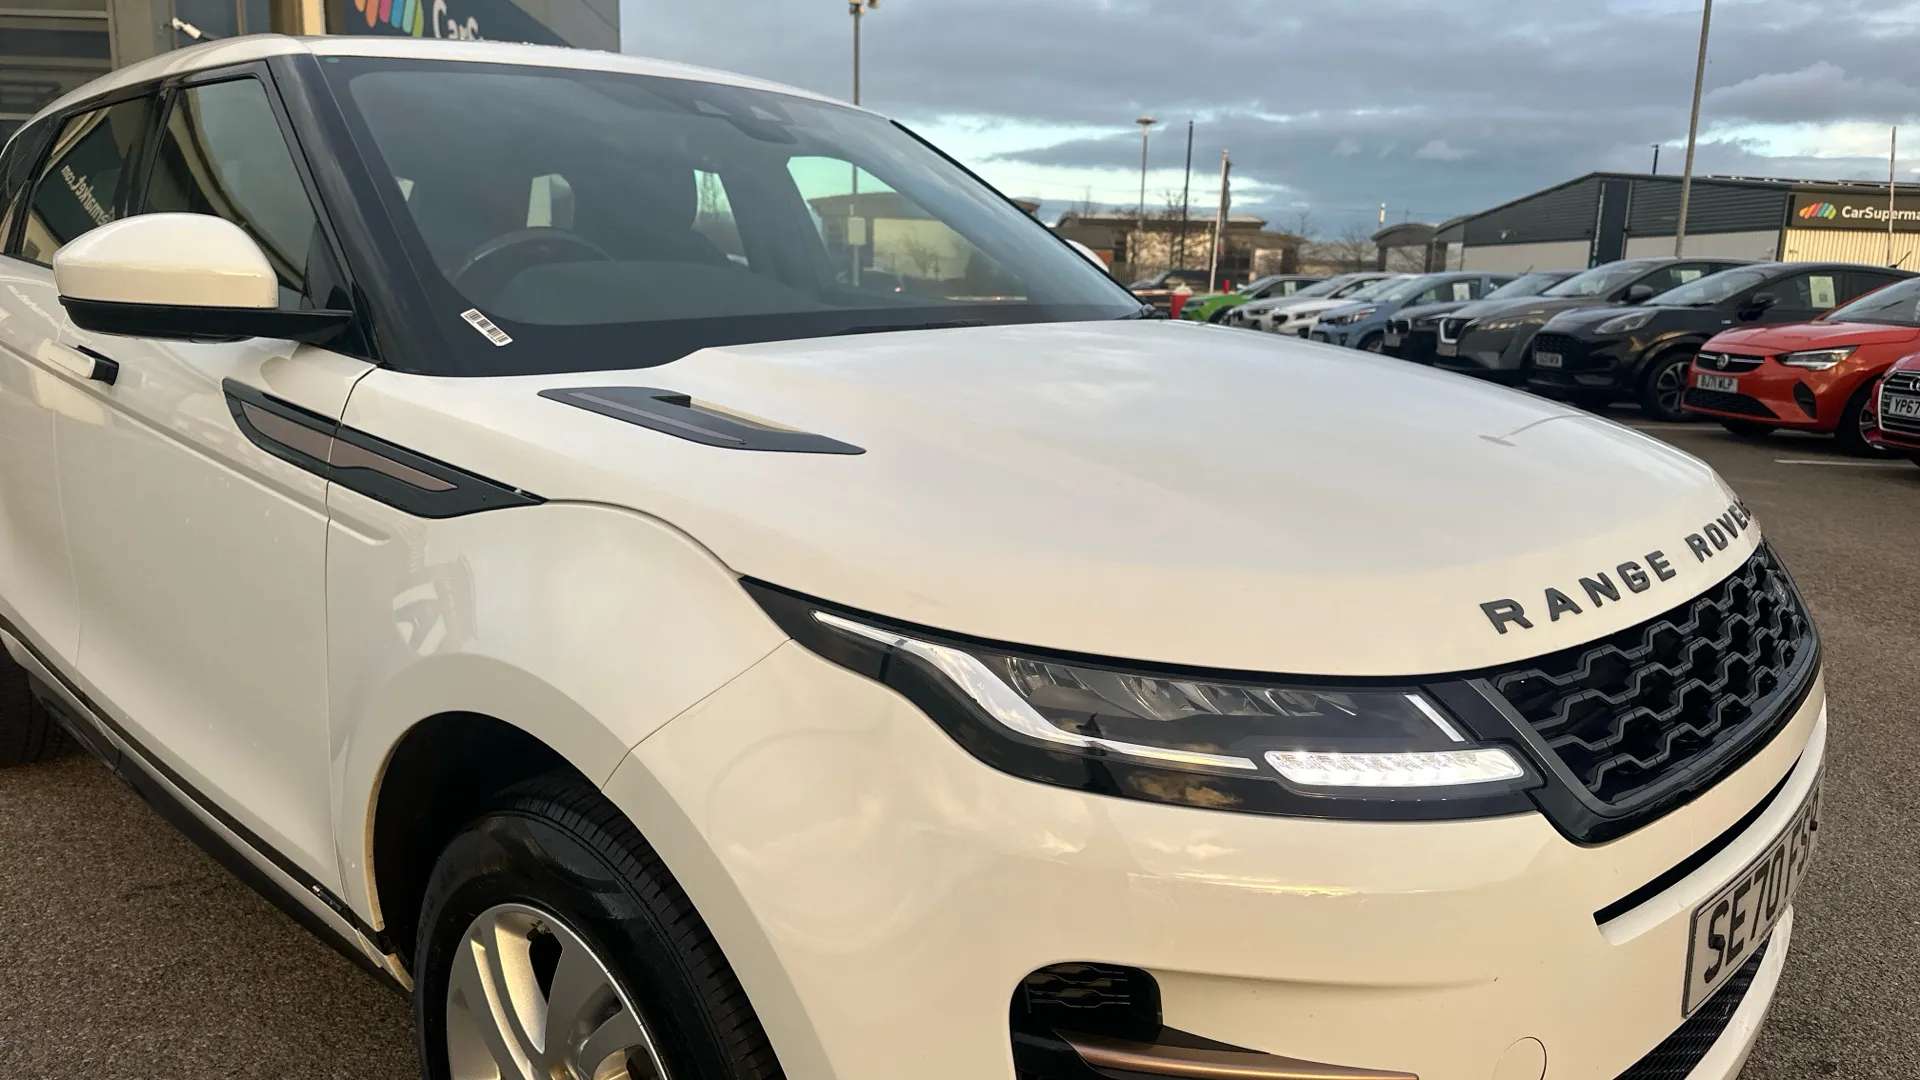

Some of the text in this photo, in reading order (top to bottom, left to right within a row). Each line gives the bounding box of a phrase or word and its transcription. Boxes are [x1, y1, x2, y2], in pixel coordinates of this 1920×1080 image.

[1895, 398, 1920, 415] YP67
[1480, 550, 1677, 635] RANGE
[1704, 844, 1785, 984] SE70
